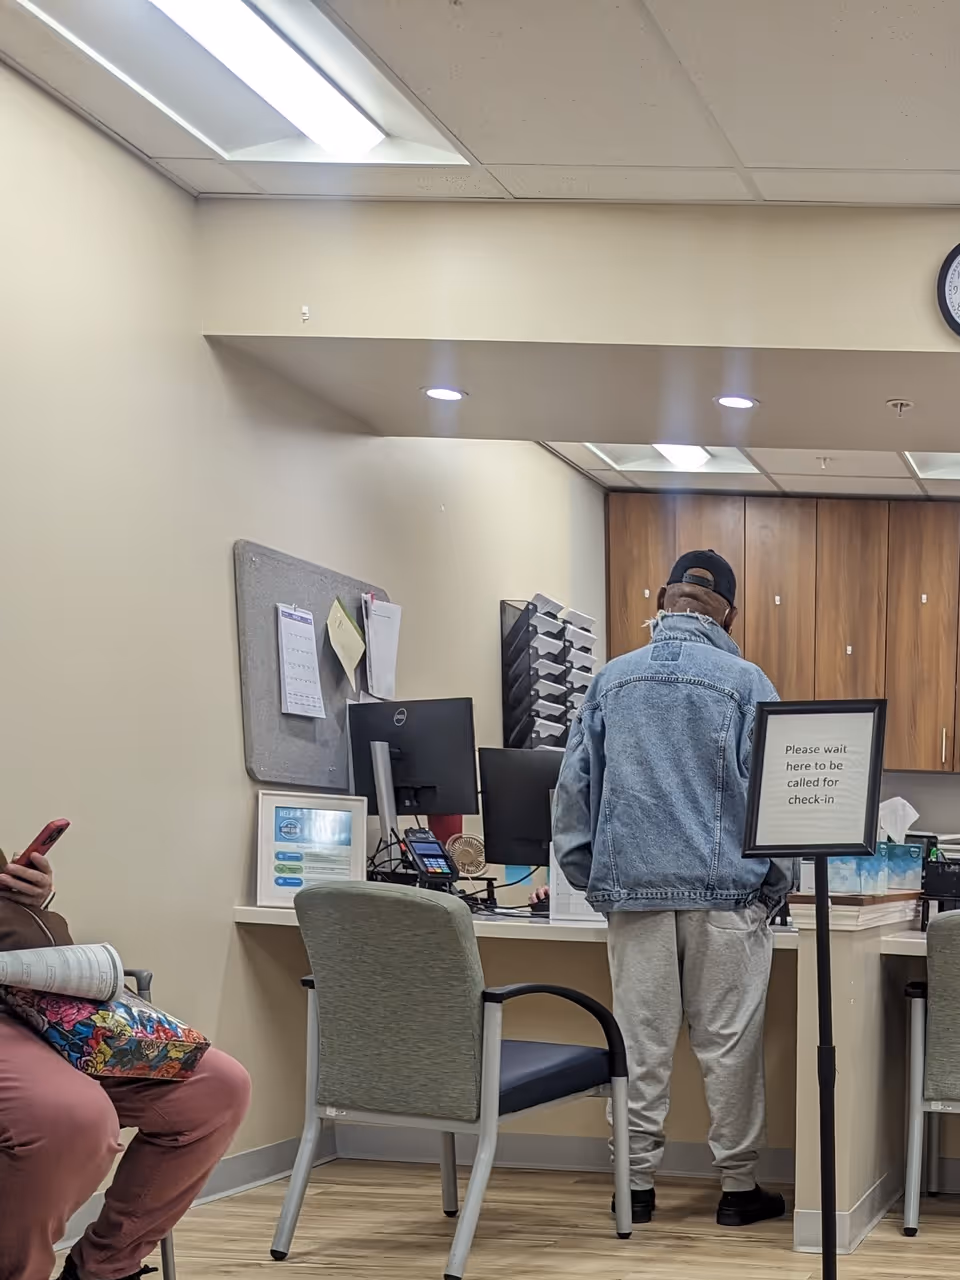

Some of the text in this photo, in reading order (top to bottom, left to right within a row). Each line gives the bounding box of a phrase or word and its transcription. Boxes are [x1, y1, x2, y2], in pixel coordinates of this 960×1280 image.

[953, 286, 958, 295] 9
[785, 744, 847, 754] Please wait
[786, 760, 843, 771] here to be
[787, 777, 839, 787] called for
[788, 794, 835, 804] check-in
